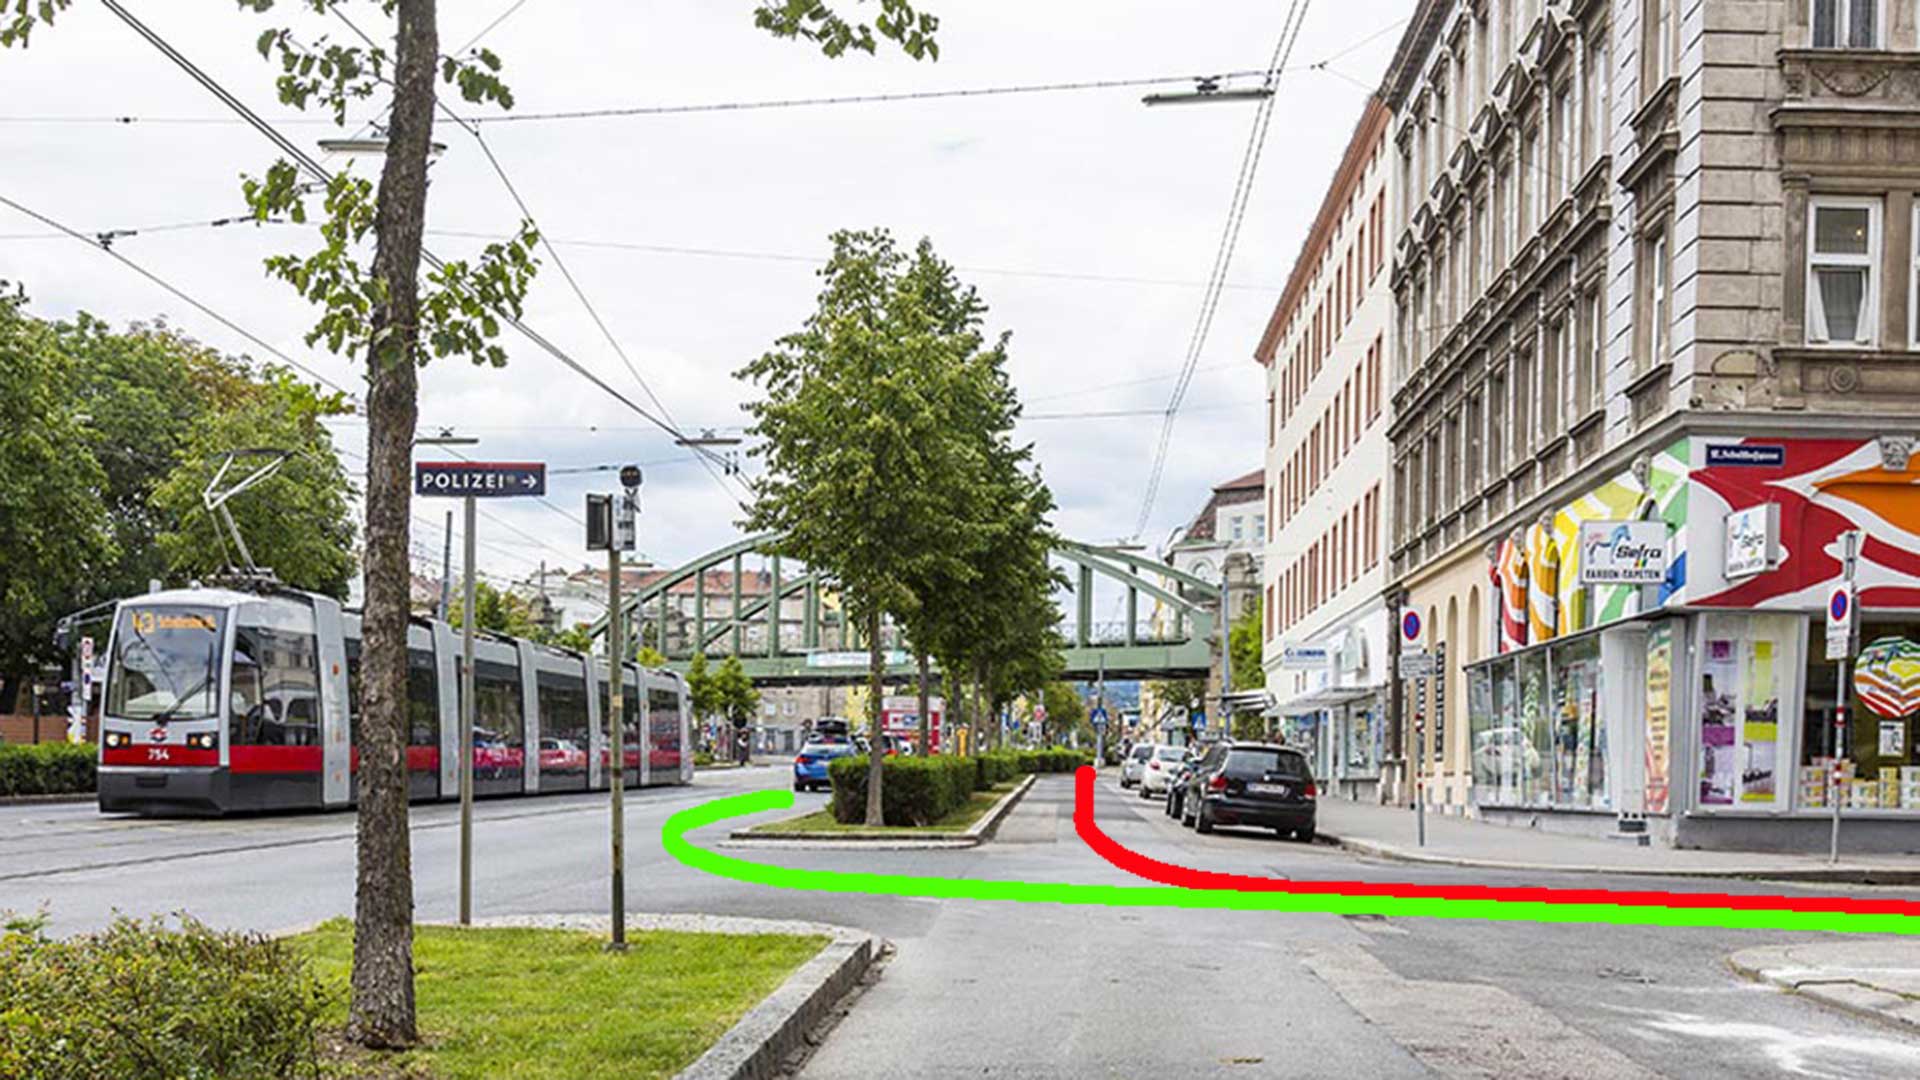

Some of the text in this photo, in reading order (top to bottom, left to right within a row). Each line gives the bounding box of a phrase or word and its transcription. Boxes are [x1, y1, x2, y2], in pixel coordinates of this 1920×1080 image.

[422, 473, 503, 488] POLIZEI
[1616, 544, 1661, 560] Sefra
[148, 748, 169, 760] 754
